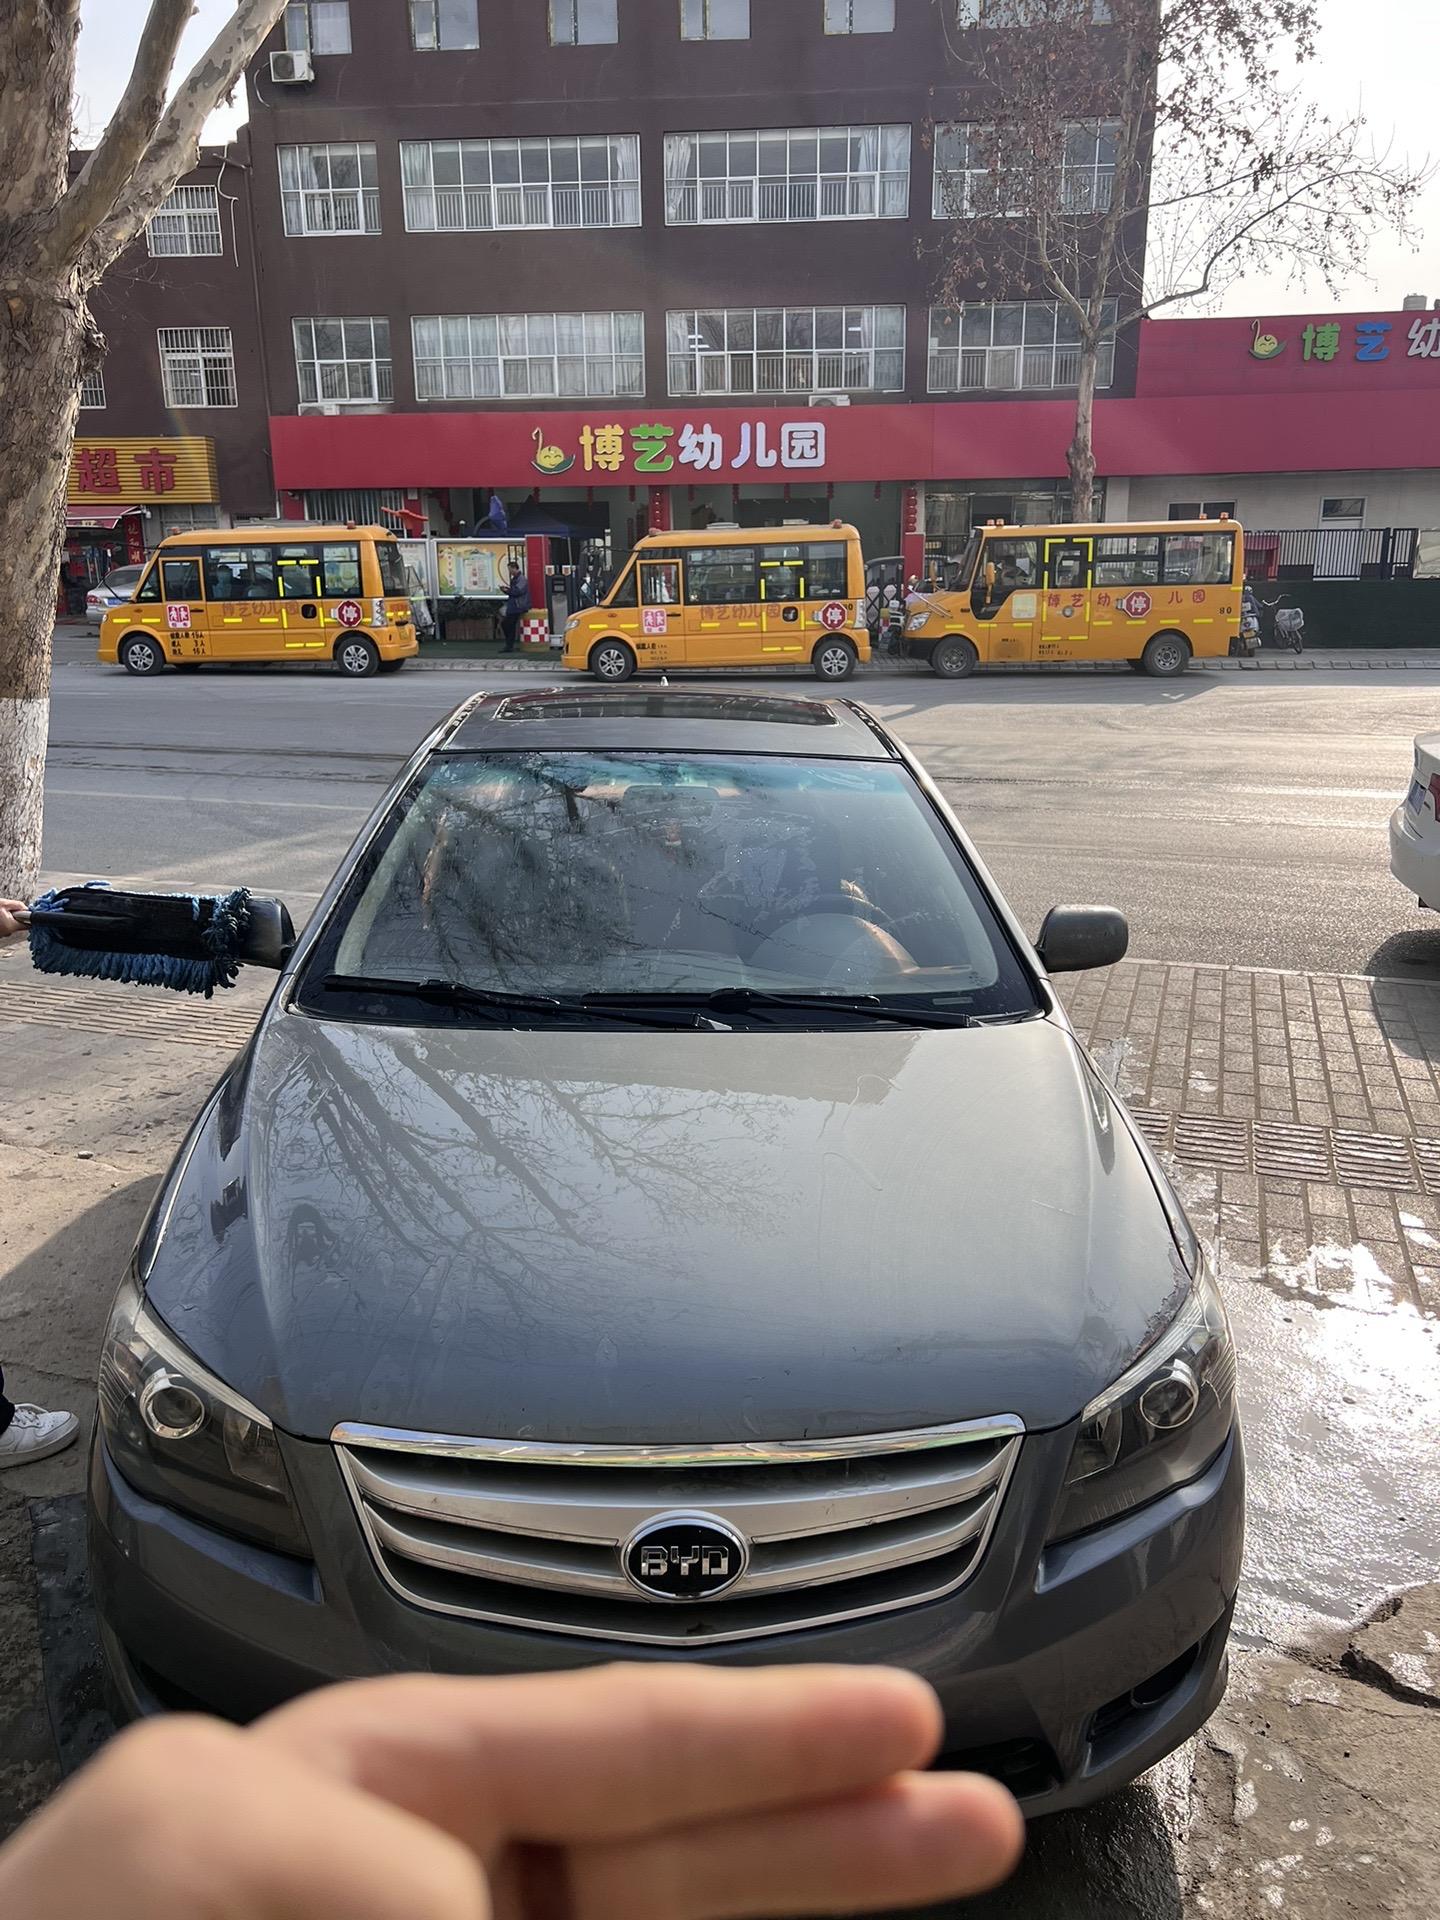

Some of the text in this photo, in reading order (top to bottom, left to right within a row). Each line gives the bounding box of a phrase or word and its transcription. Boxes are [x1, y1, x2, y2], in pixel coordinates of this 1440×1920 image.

[579, 421, 826, 472] 博艺幼儿园
[75, 447, 177, 494] 超市
[700, 603, 781, 620] 博艺幼儿园
[1130, 595, 1147, 612] 停
[1219, 606, 1232, 615] 80
[342, 605, 358, 622] 停
[827, 607, 843, 625] 停
[641, 1545, 729, 1576] BYD
